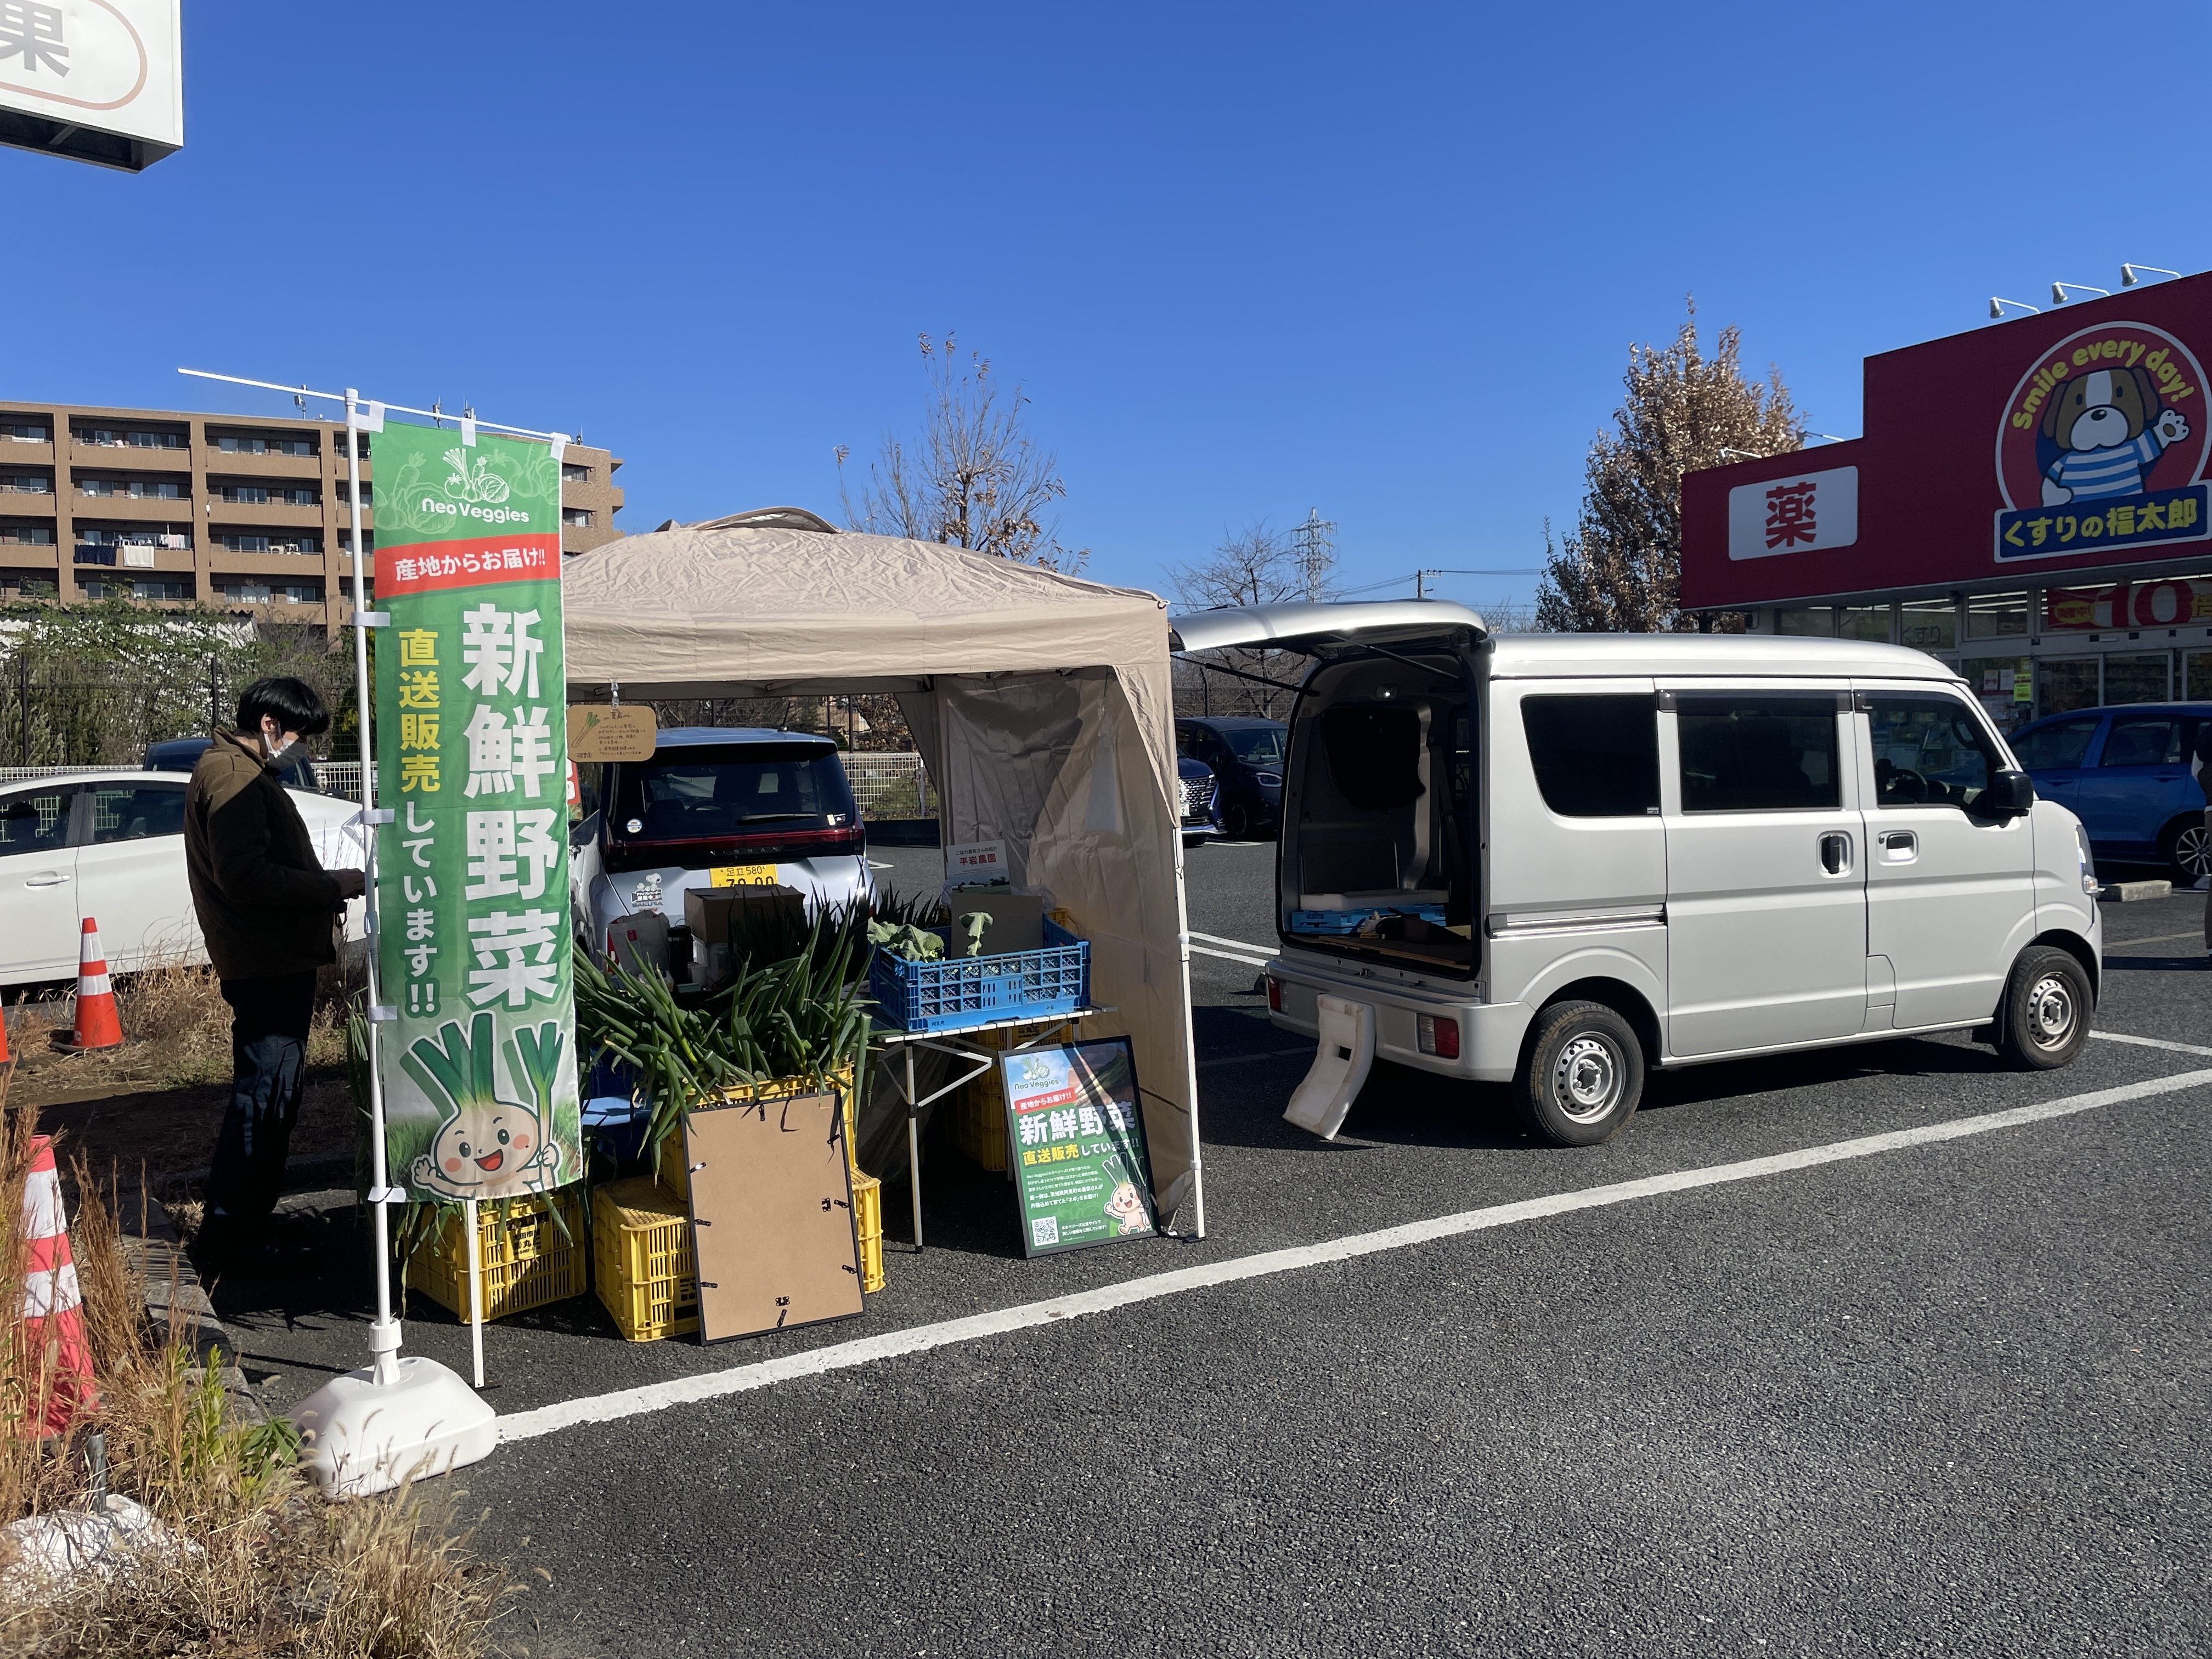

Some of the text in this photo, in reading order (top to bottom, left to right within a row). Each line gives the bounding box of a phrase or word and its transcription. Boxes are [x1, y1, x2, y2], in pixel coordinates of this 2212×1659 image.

[0, 0, 70, 77] 果
[2013, 340, 2194, 430] Smile every day!
[459, 503, 530, 524] Veggies
[1765, 482, 1818, 549] 薬
[2005, 498, 2198, 547] くすりの福太郎
[461, 603, 560, 1008] 新鮮野菜
[1030, 1078, 1059, 1088] Veggies
[1018, 1101, 1136, 1146] 新鮮野菜
